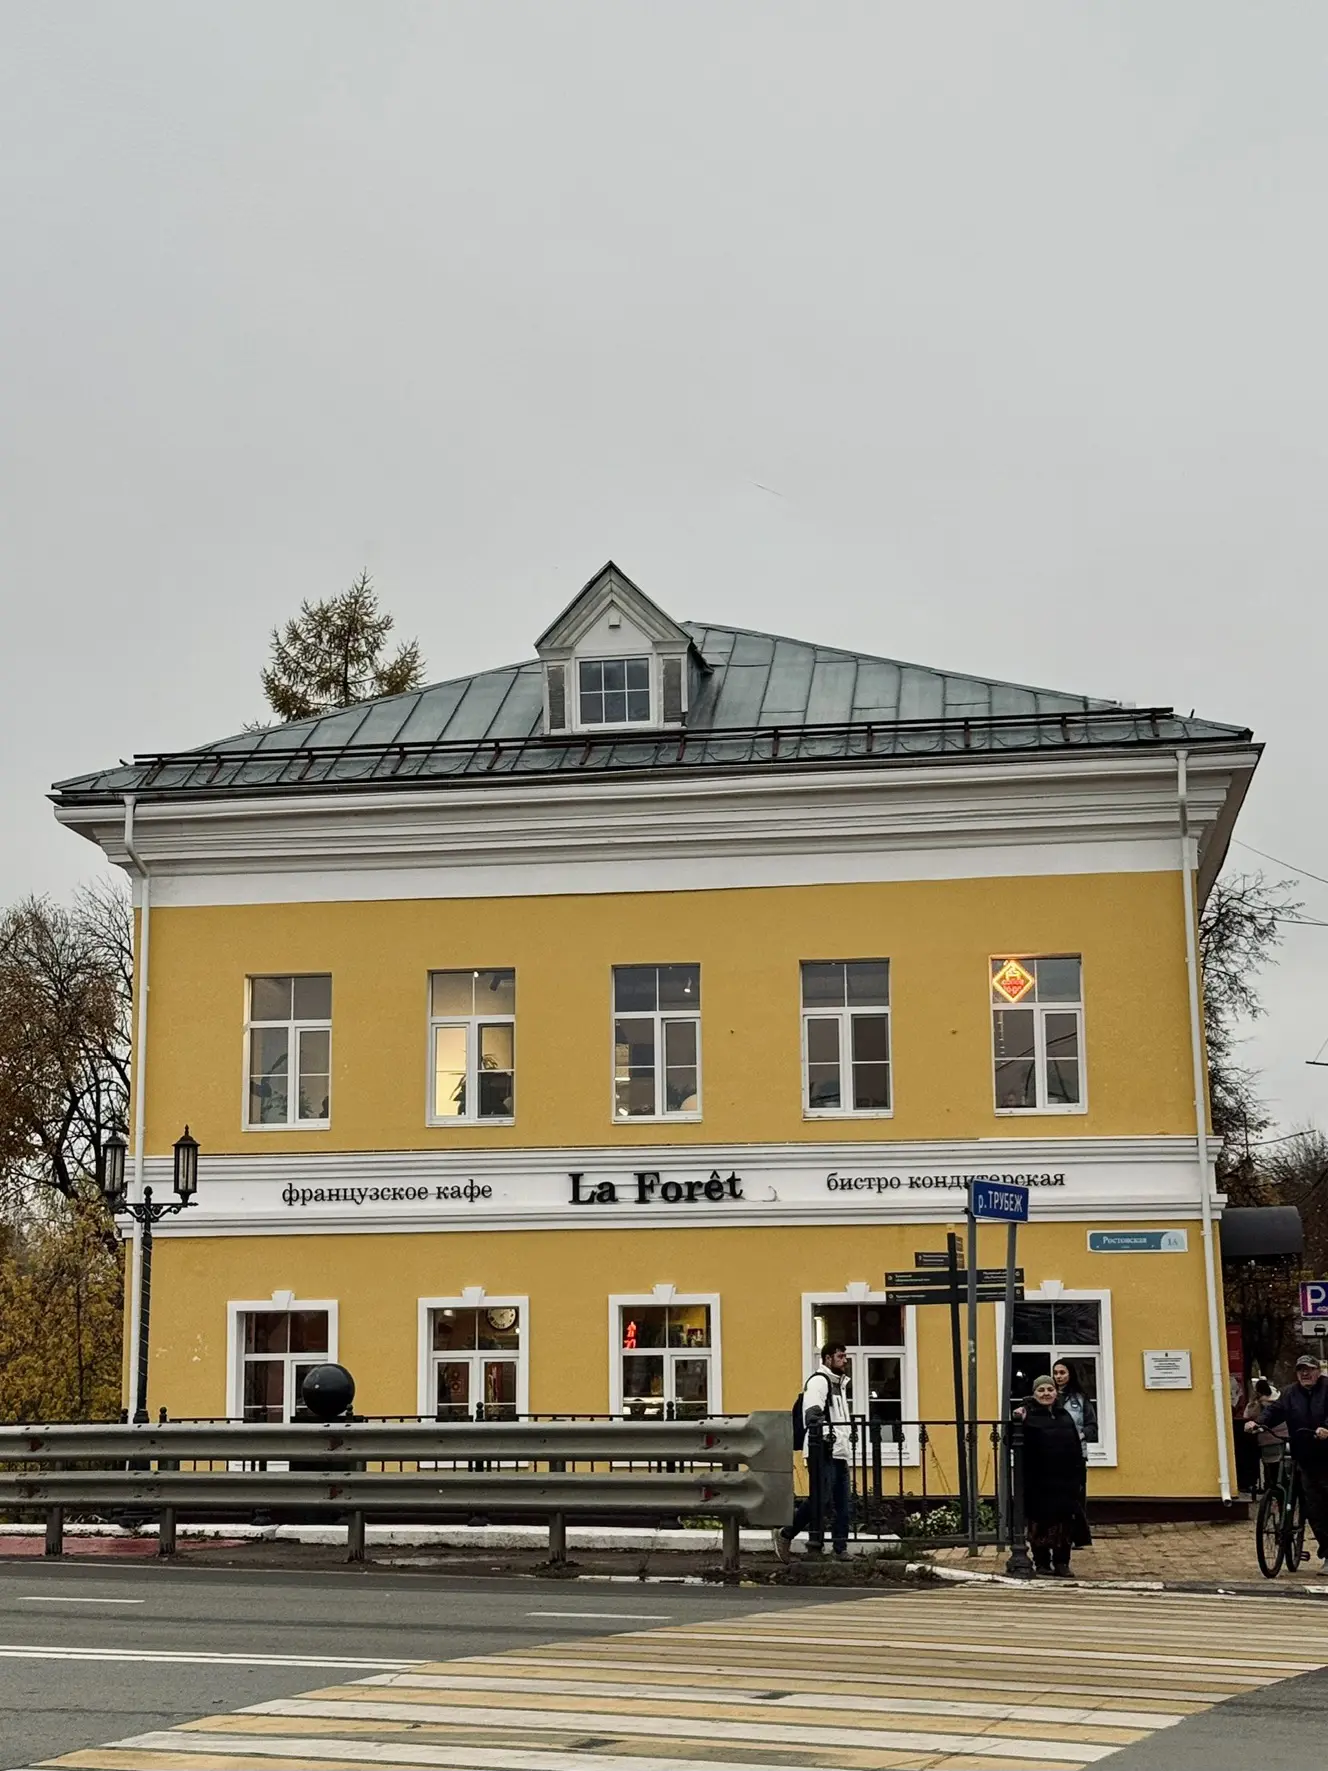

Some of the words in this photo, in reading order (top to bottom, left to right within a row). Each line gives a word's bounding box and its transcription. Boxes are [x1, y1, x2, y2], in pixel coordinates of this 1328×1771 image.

[282, 1182, 429, 1206] французское
[435, 1179, 493, 1203] кафе
[568, 1173, 619, 1204] La
[633, 1169, 744, 1204] Forêt
[827, 1172, 901, 1193] бистро
[977, 1194, 987, 1214] р.
[987, 1190, 1024, 1213] ТРУБЕЖ
[1306, 1285, 1327, 1313] P
